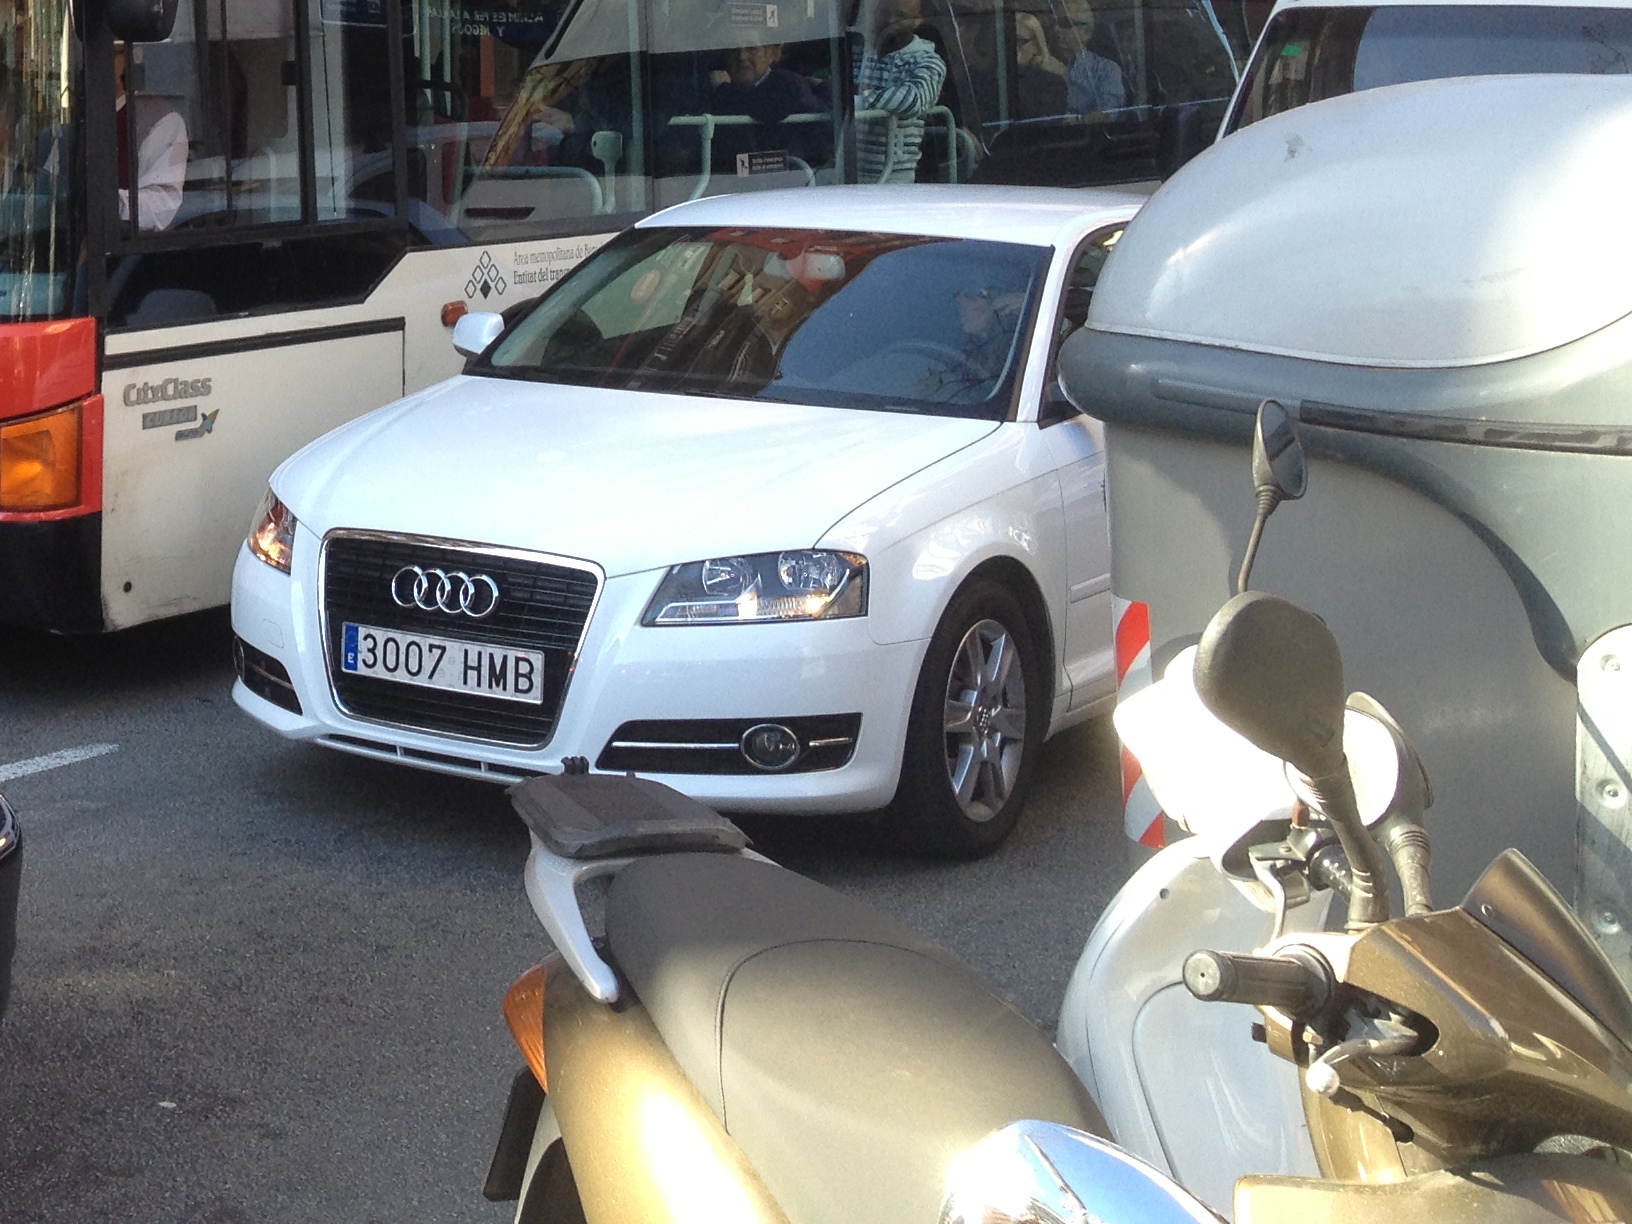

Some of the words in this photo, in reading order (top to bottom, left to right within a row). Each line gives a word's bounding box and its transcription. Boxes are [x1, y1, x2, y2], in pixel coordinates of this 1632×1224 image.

[123, 378, 212, 407] CityClass
[347, 652, 355, 664] E
[361, 633, 447, 681] 3007
[463, 648, 536, 695] HMB
